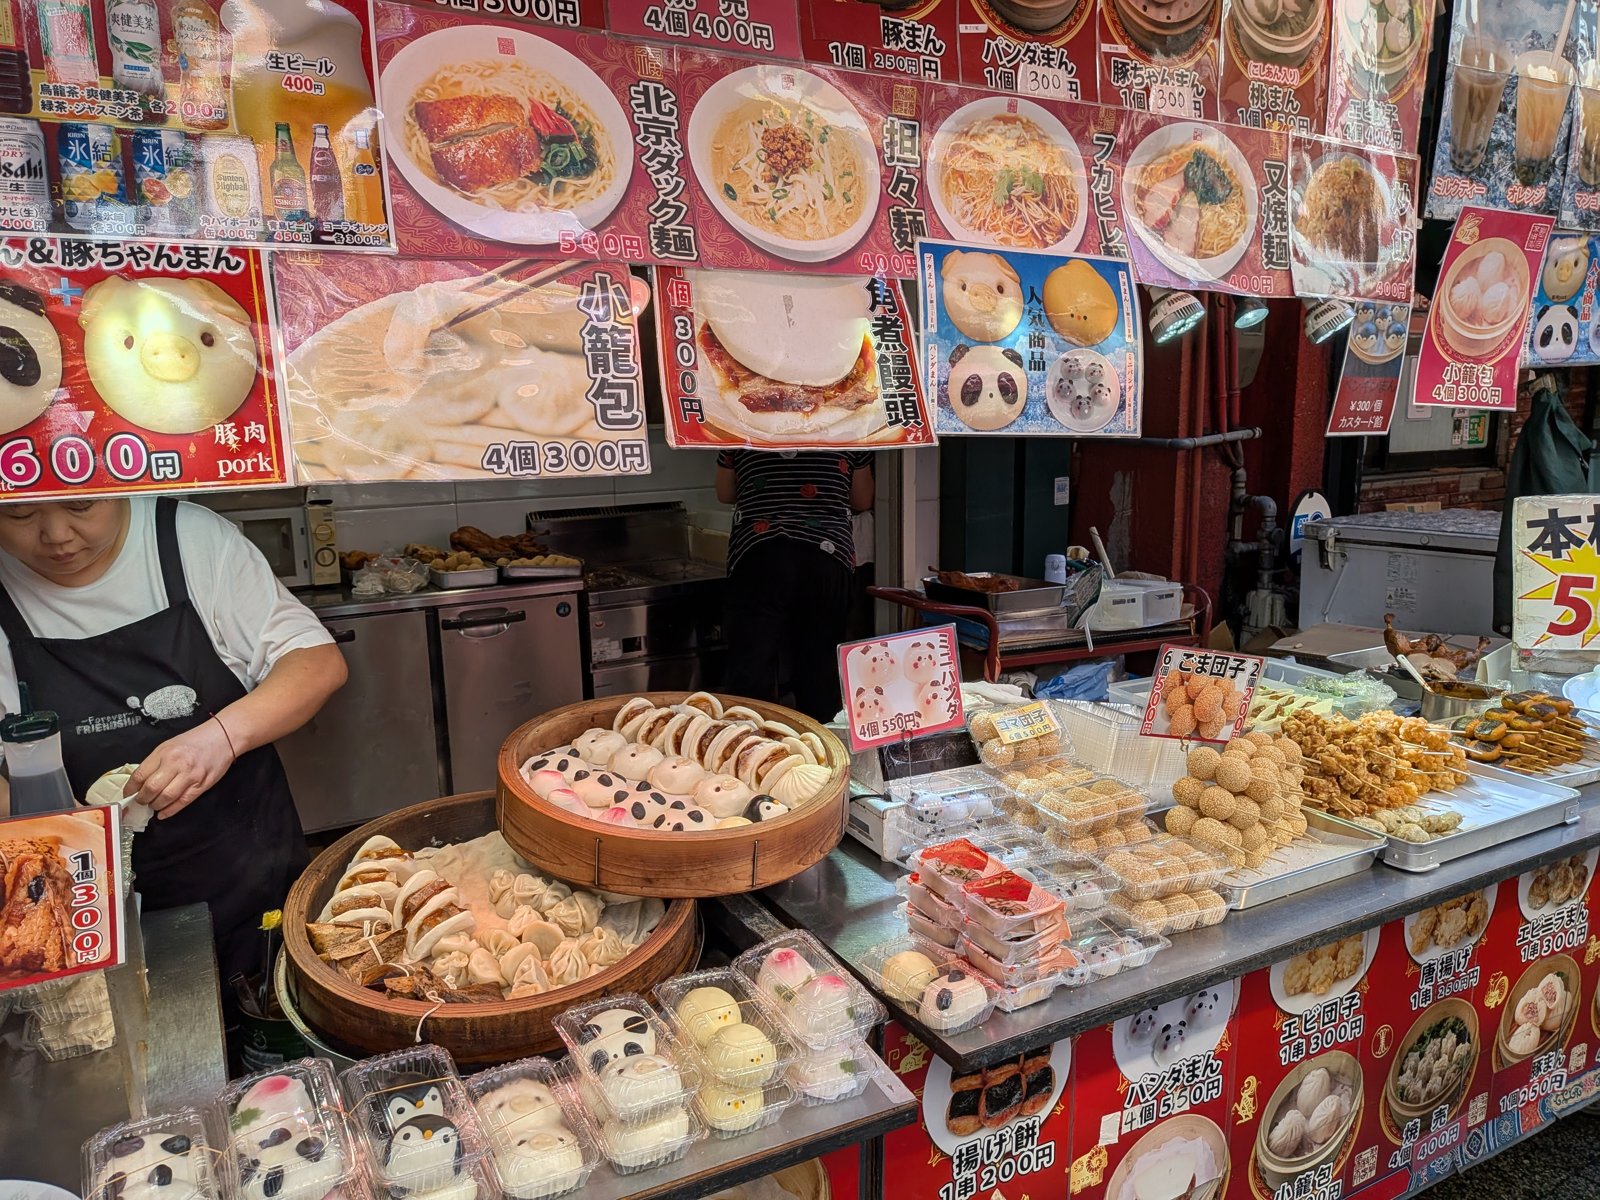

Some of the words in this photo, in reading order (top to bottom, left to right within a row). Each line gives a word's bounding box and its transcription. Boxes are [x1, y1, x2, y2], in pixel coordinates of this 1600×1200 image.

[644, 6, 775, 51] 4個400円
[880, 17, 946, 55] 豚まん
[267, 51, 336, 77] 生ビール
[982, 37, 1077, 76] パンダまん
[282, 75, 325, 96] 400円
[1249, 82, 1301, 113] 桃まん
[150, 100, 224, 119] 各200円
[67, 139, 112, 164] 氷結
[0, 158, 43, 180] sahi
[217, 175, 246, 187] Suntory
[629, 80, 698, 261] 北京ダック麺
[9, 182, 26, 192] 生
[1434, 176, 1486, 200] ミルクティー
[1507, 185, 1546, 206] オレンジ
[1574, 193, 1600, 211] マンゴ
[2, 219, 46, 230] 400円
[204, 228, 256, 239] 缶400円
[274, 231, 312, 243] 450円
[333, 234, 382, 245] 各300円
[559, 230, 644, 259] 500円
[1228, 274, 1274, 294] 400円
[1375, 281, 1407, 299] 400円
[1026, 285, 1046, 372] 人気商品
[583, 272, 641, 430] 小籠包
[865, 277, 923, 428] 角煮饅頭
[1443, 362, 1494, 386] 小籠包
[1432, 385, 1502, 404] 4個300円
[214, 421, 266, 446] 豚肉
[216, 454, 273, 478] pork
[481, 441, 646, 476] 4個300円
[1179, 652, 1247, 679] ごま団子
[75, 715, 142, 736] FRIENDSHIP
[858, 714, 917, 738] 4個550円
[70, 851, 103, 962] 1個300円
[1516, 902, 1588, 946] エビニラまん
[1520, 923, 1588, 962] 1串300円
[1419, 944, 1473, 988] 唐揚げ
[1280, 992, 1360, 1043] エビ団子
[1280, 1015, 1363, 1065] 1串300円
[1124, 1051, 1222, 1108] パンダまん
[953, 1117, 1041, 1180] 揚げ餅
